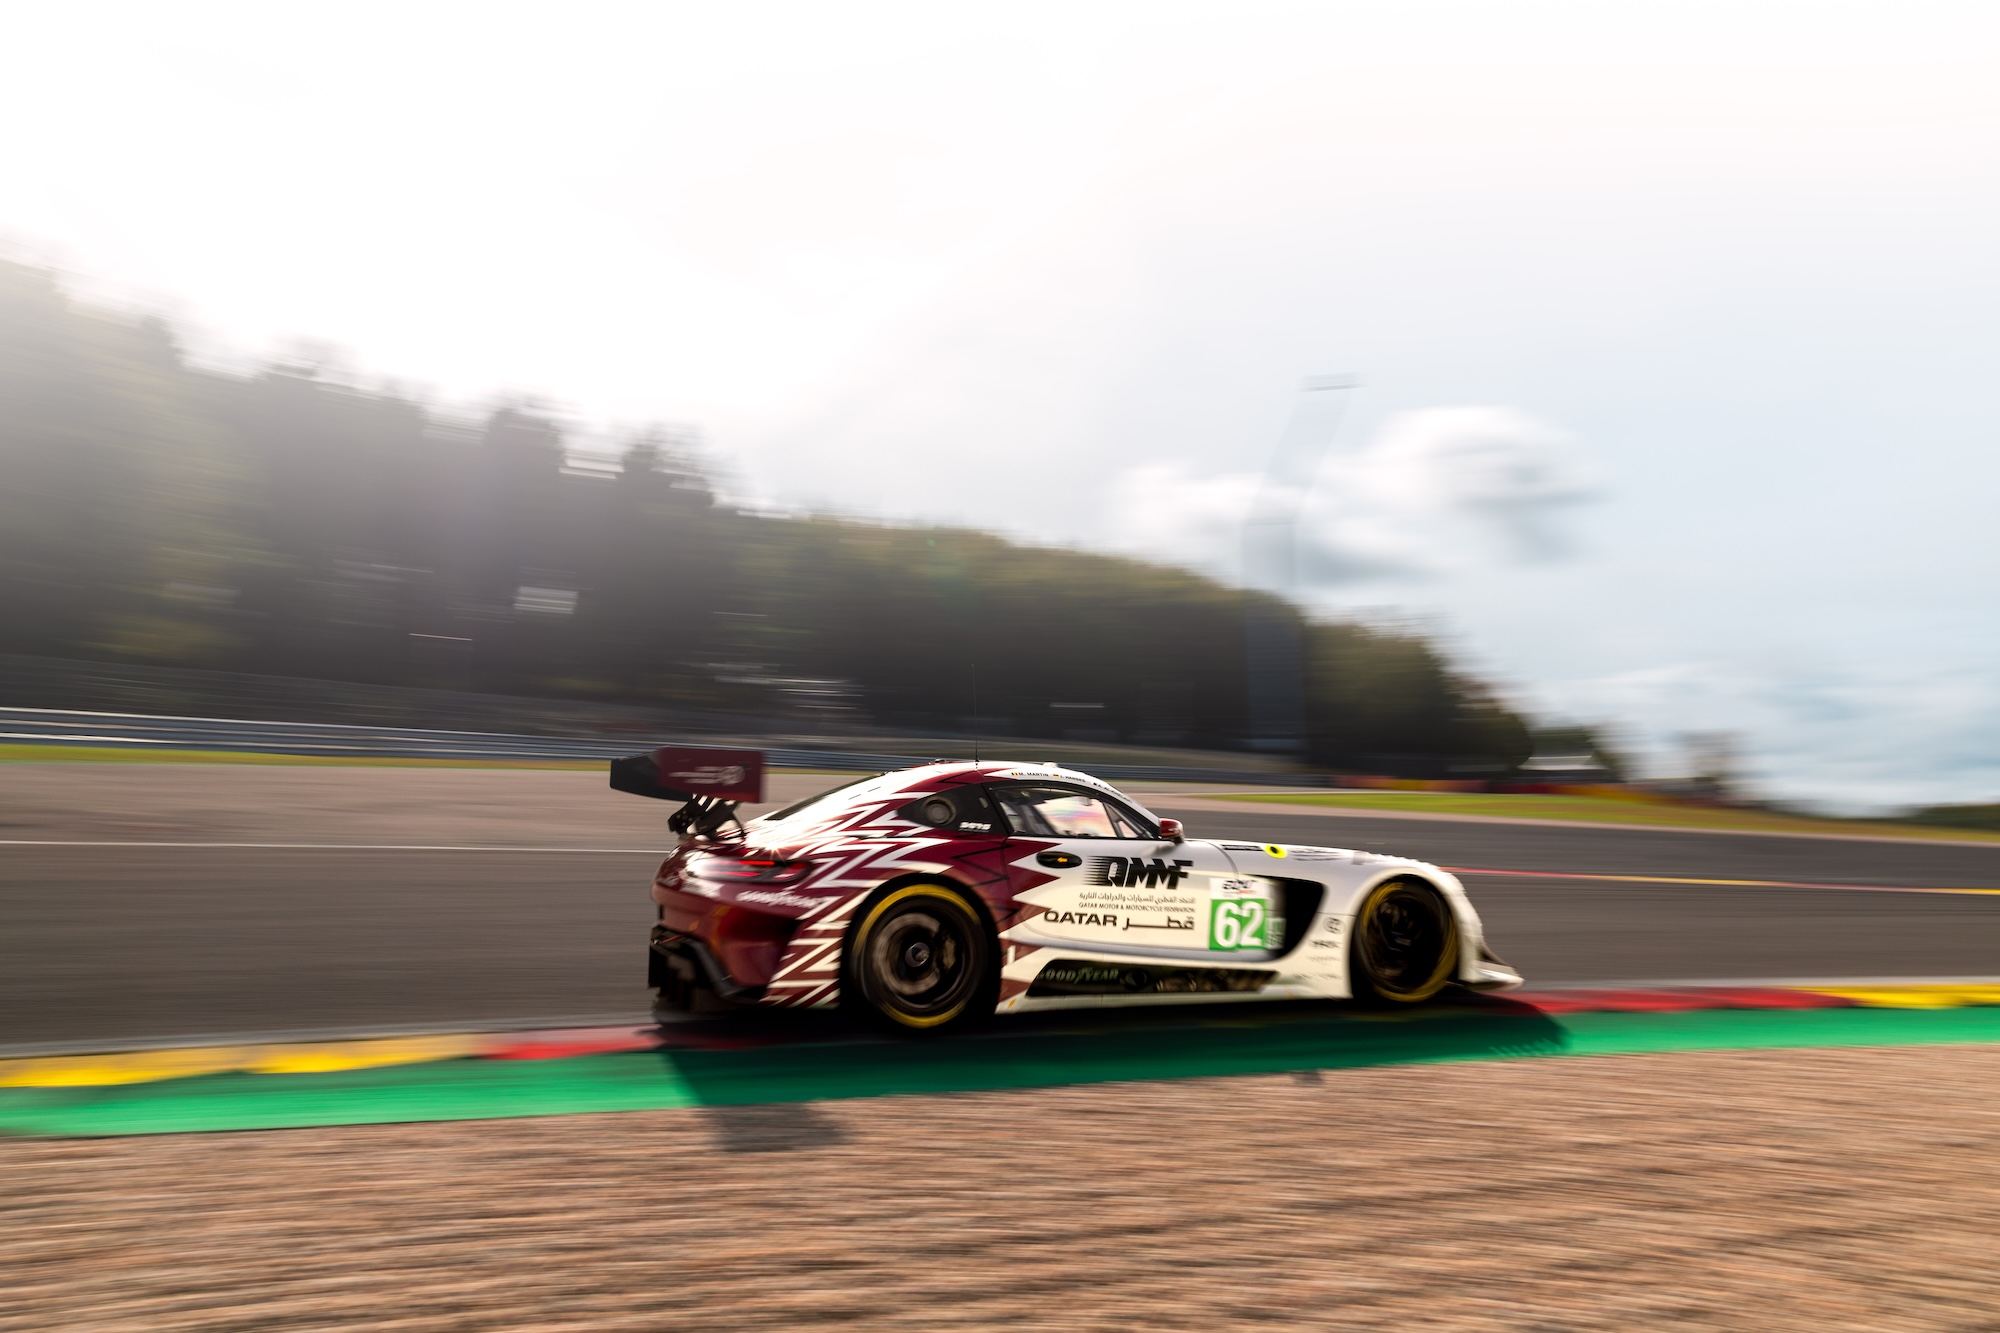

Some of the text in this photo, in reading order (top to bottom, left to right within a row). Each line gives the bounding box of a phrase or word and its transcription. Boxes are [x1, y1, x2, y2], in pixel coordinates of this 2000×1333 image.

[1082, 855, 1194, 890] QMMF
[1126, 904, 1163, 912] MOTORCYCLE
[1044, 911, 1118, 927] QATAR
[1122, 915, 1195, 931] قطر
[1214, 901, 1264, 949] 62
